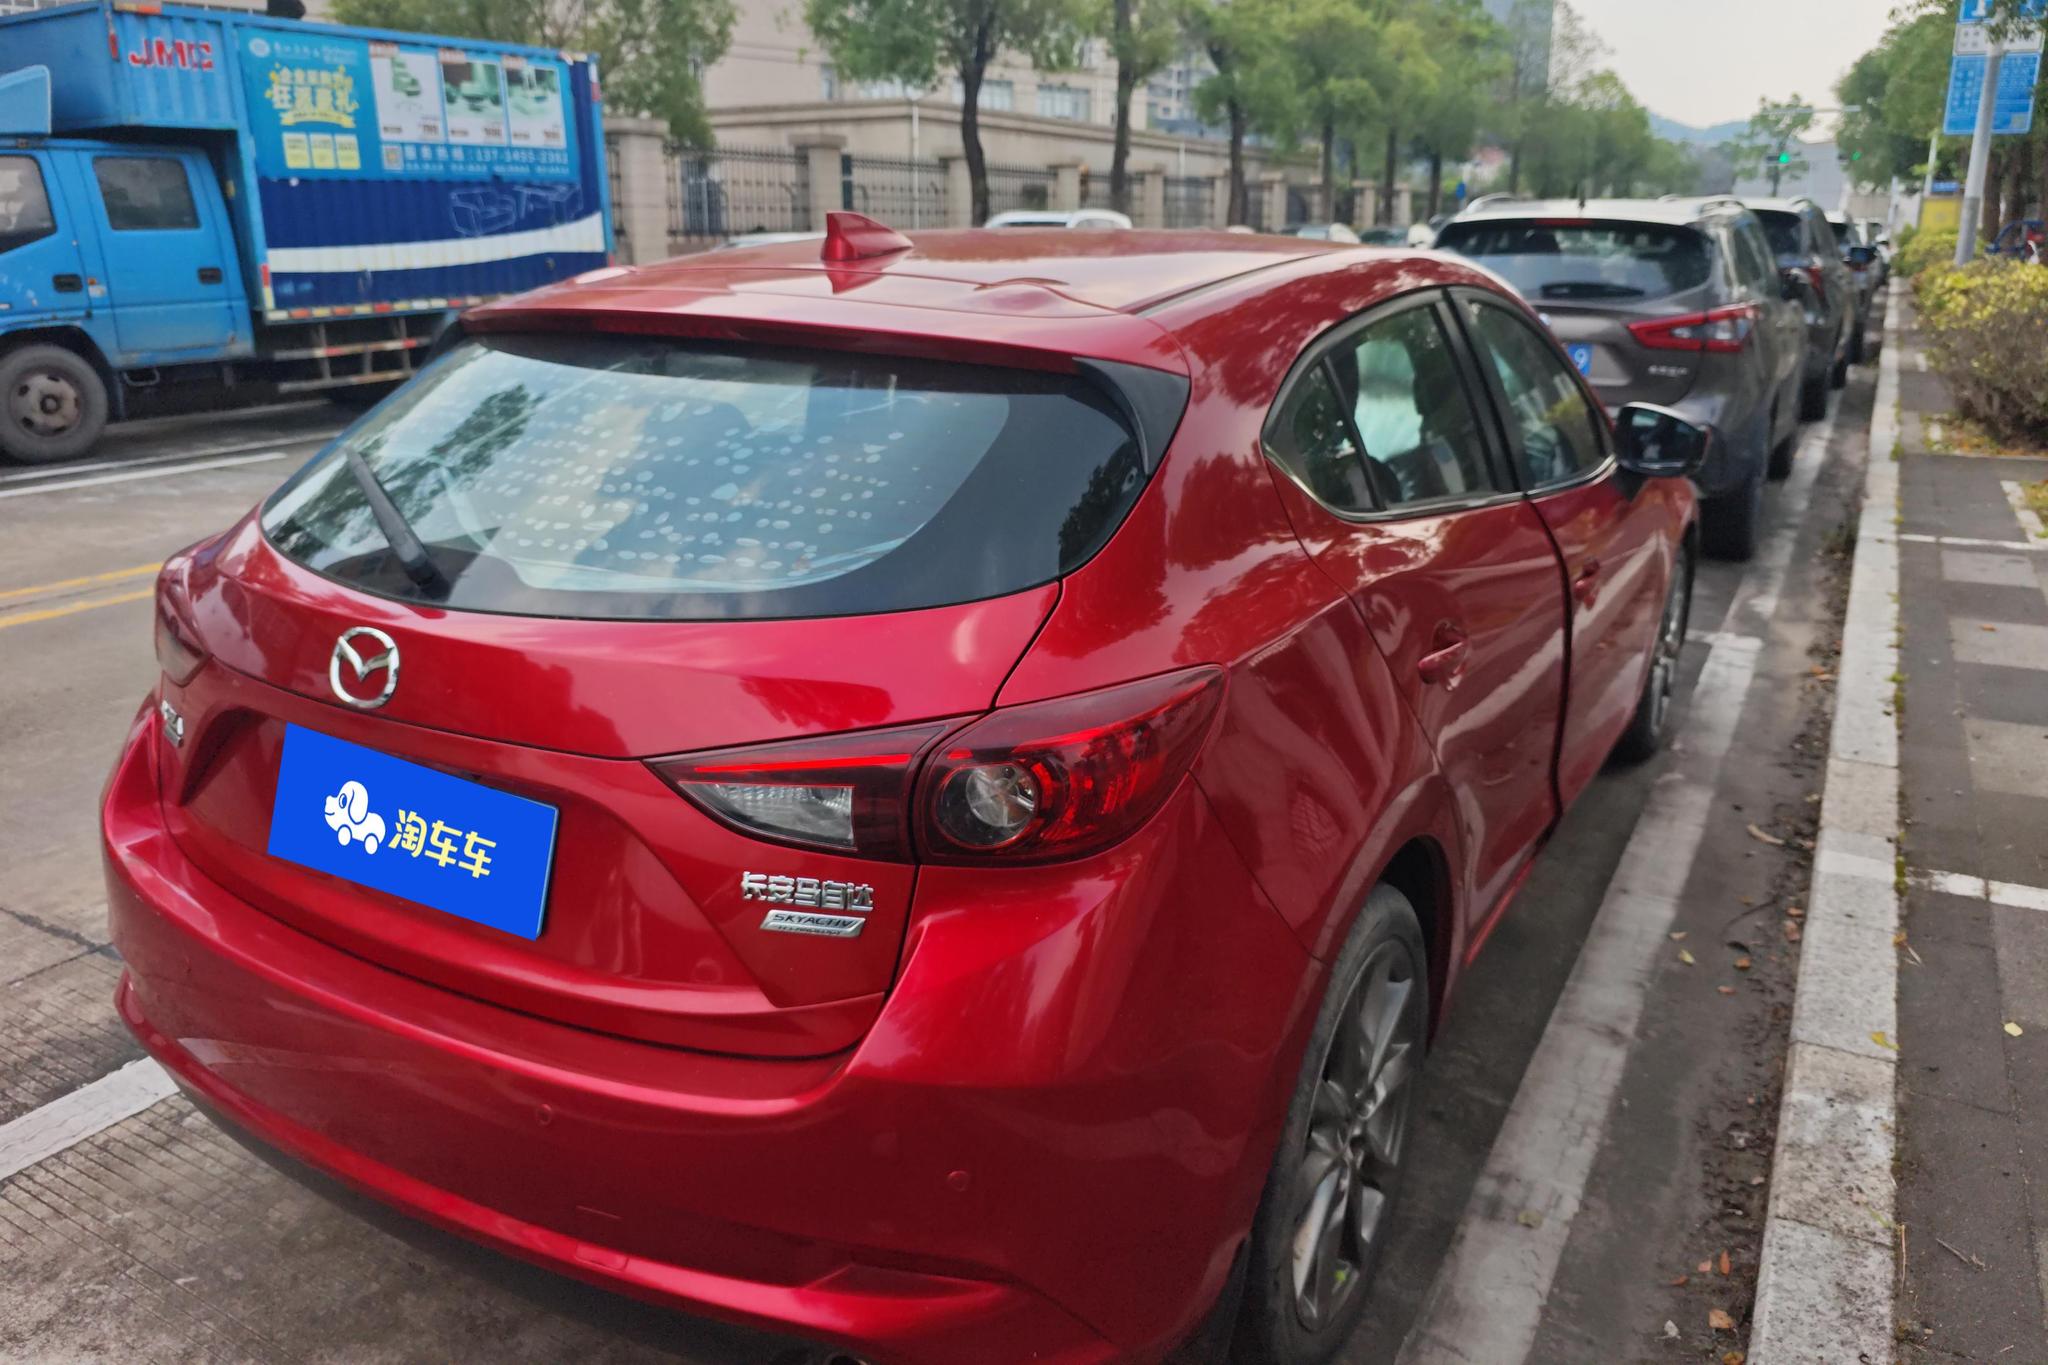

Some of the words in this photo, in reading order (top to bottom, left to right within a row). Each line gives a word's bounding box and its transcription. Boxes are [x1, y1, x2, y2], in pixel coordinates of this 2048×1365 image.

[129, 38, 214, 71] JMC
[741, 871, 874, 912] 长安马自达
[773, 913, 853, 928] SKYACTIV
